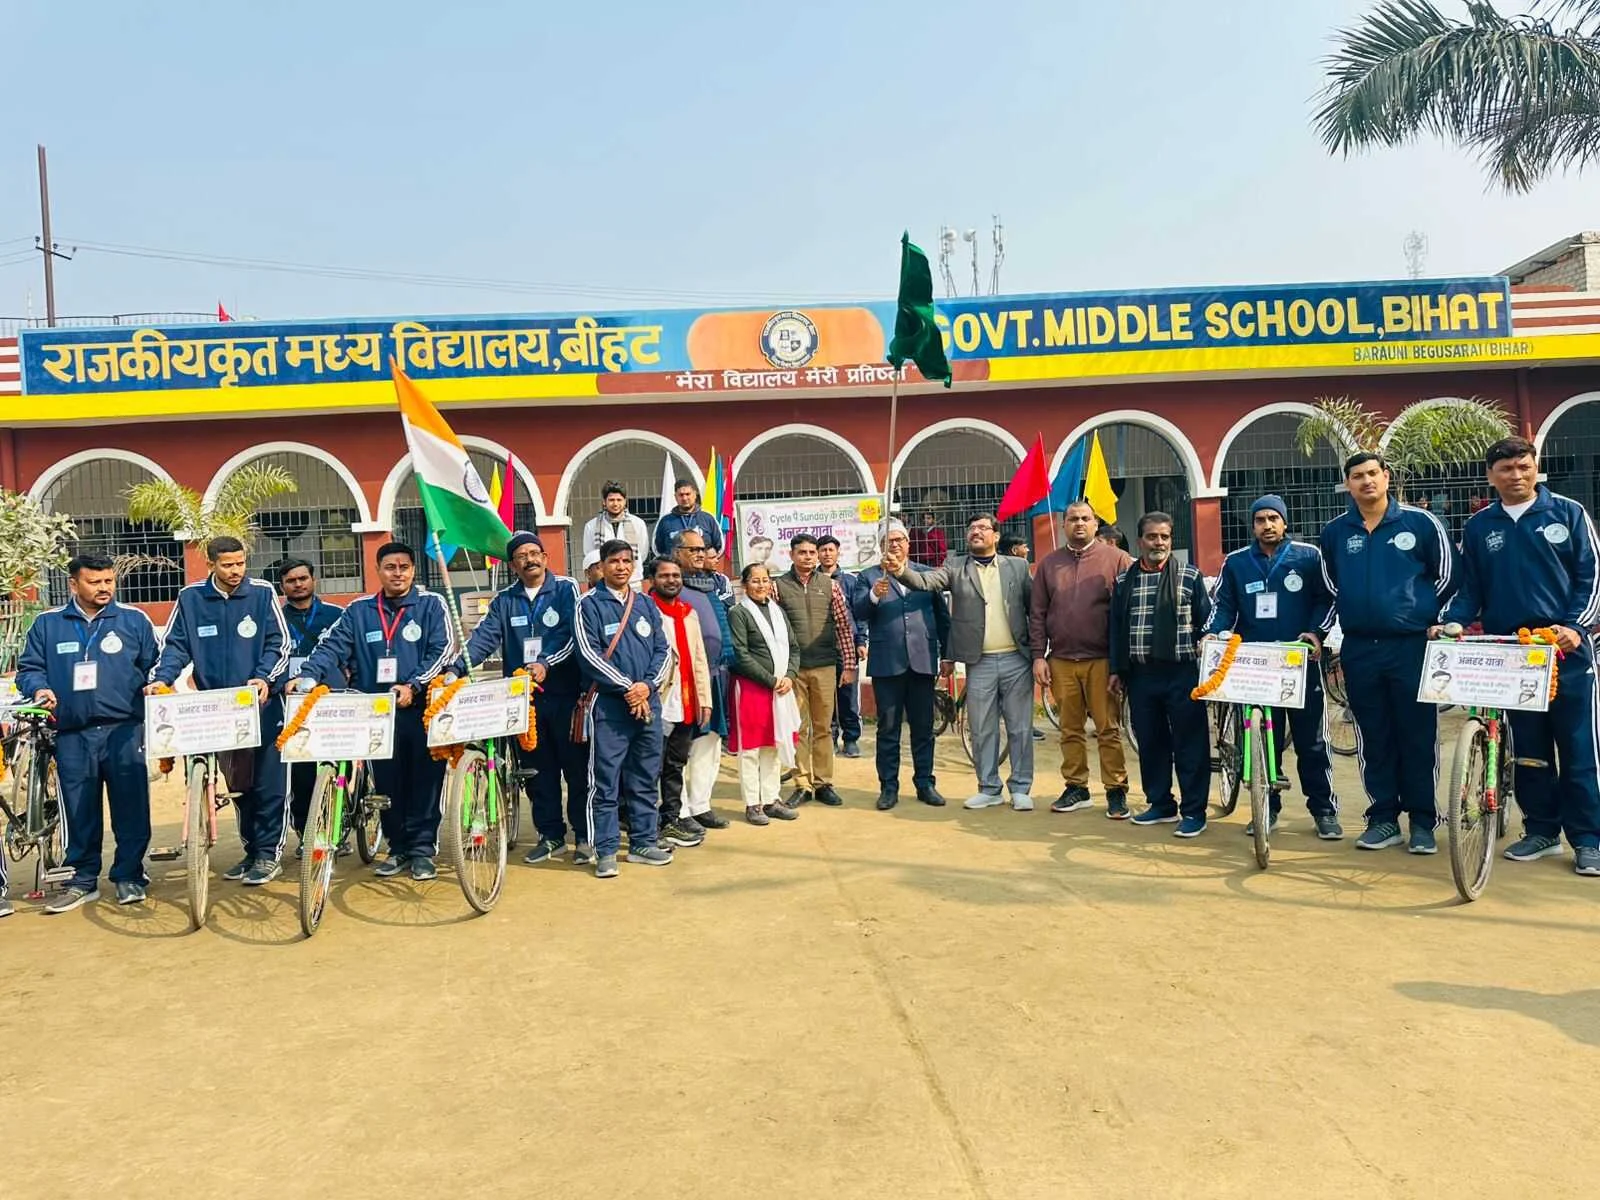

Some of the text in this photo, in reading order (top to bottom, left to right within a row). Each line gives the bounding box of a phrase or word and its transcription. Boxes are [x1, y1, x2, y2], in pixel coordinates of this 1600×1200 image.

[41, 328, 278, 389] राजकीयकृत
[285, 333, 383, 375] मध्य
[1353, 345, 1408, 362] BARAUNI
[770, 513, 791, 525] Cycle
[800, 511, 829, 522] Sunday
